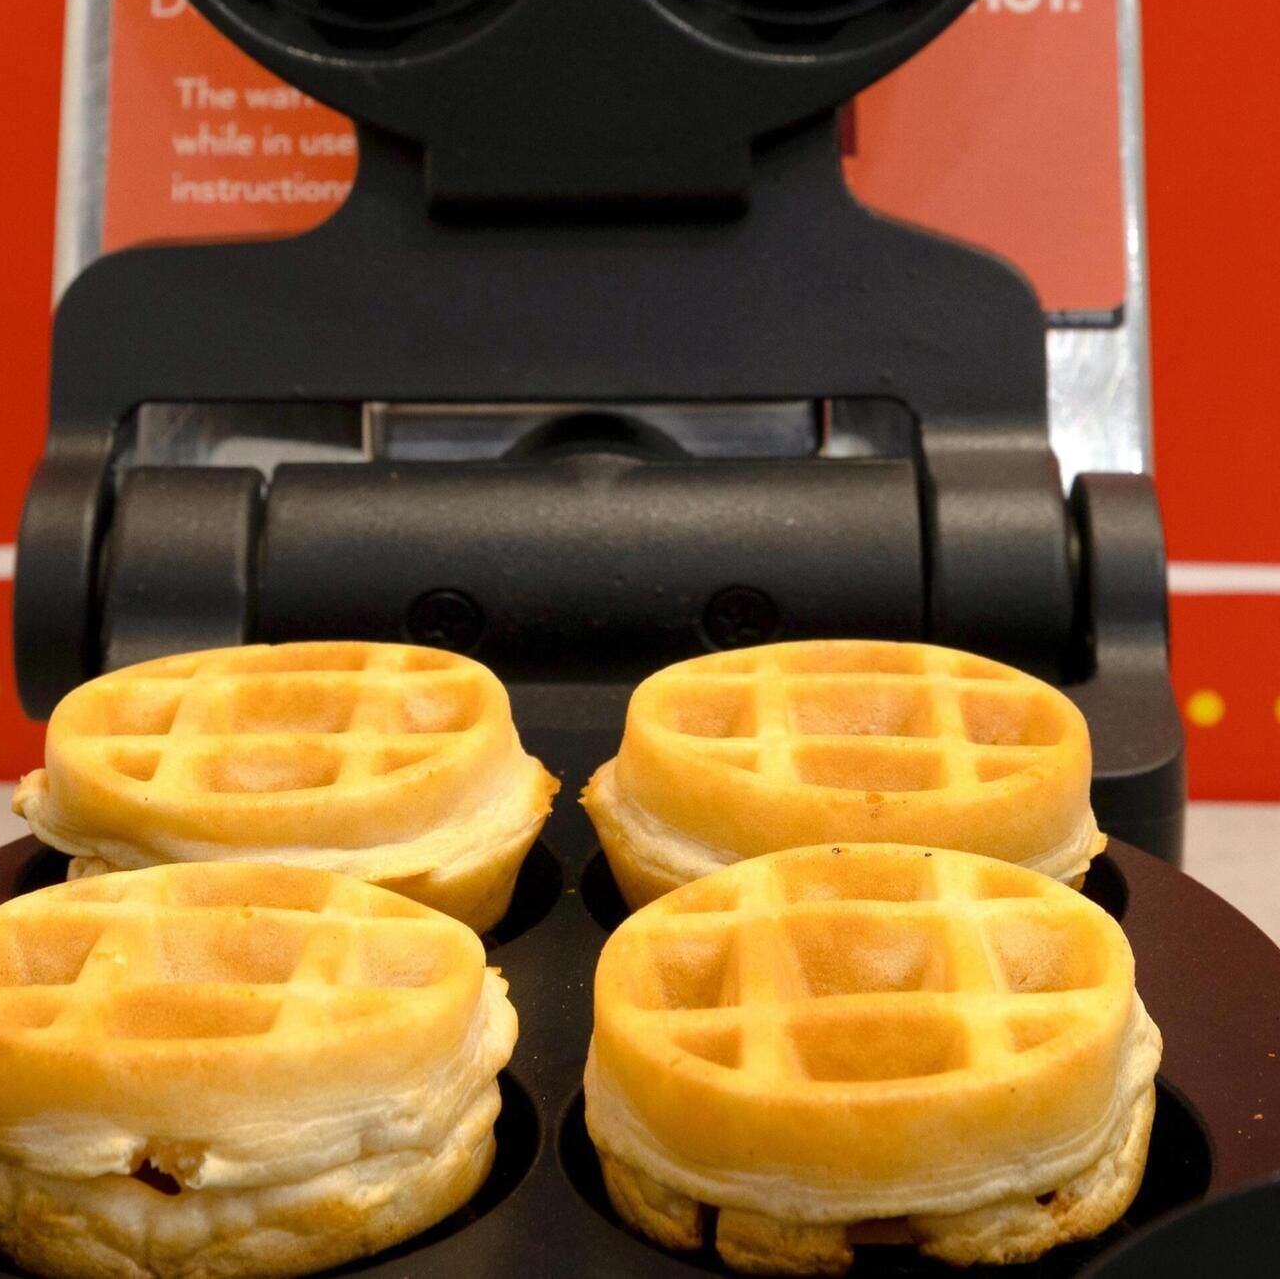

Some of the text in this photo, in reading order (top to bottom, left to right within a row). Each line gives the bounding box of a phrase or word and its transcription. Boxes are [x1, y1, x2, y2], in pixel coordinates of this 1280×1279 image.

[176, 76, 236, 109] The
[173, 124, 359, 156] while in use
